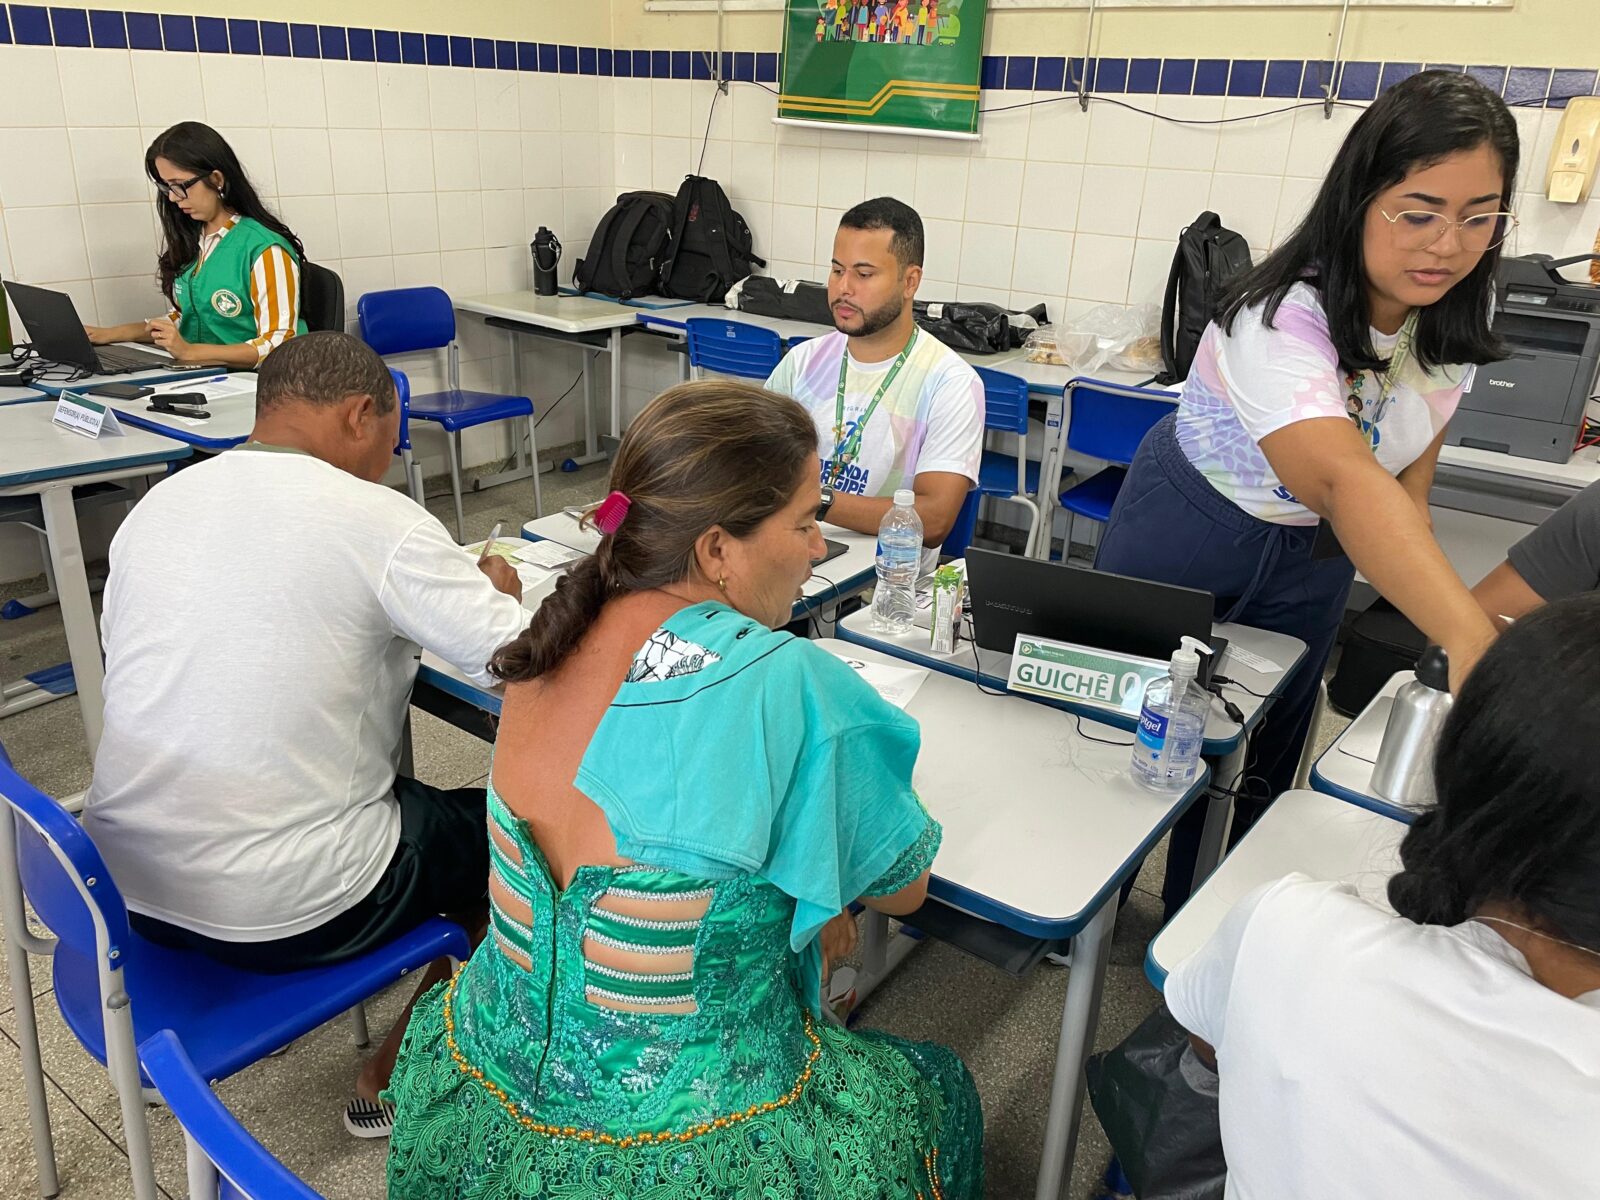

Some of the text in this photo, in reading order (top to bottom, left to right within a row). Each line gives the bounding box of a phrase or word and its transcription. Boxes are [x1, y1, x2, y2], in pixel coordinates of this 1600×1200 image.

[1488, 379, 1516, 388] brother
[1017, 663, 1155, 702] GUICHÊ 0
[1140, 715, 1162, 732] ptgel
